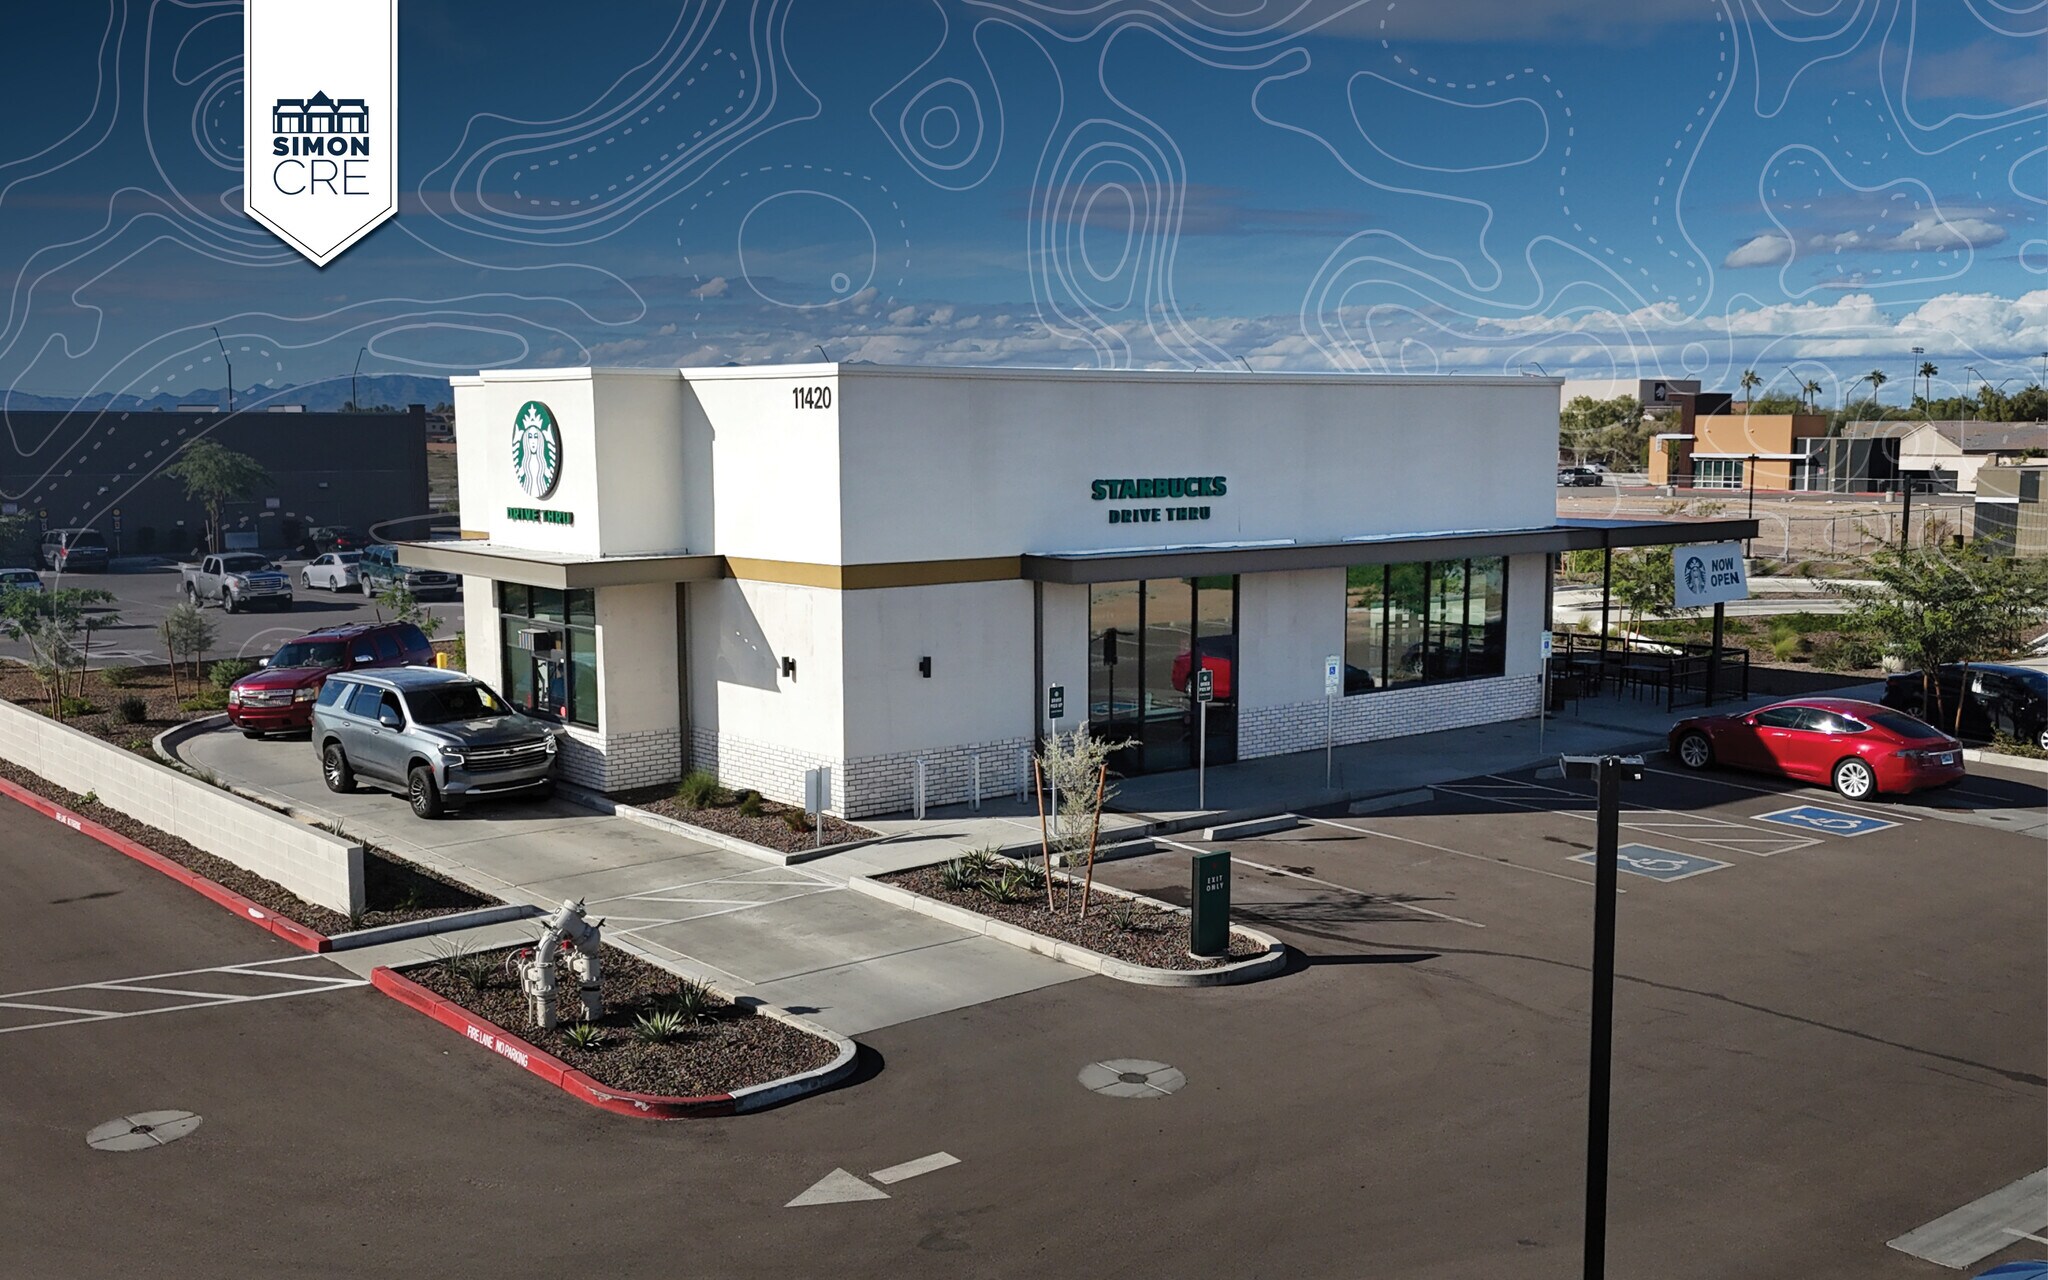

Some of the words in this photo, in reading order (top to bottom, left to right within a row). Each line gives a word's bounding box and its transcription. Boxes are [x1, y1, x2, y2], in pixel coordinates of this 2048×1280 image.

[792, 386, 832, 409] 11420
[1091, 476, 1227, 500] STARBUCKS
[507, 507, 541, 522] DRIVE
[540, 510, 574, 526] THRU
[1109, 508, 1161, 524] DRIVE
[1166, 506, 1211, 521] THRU
[1711, 557, 1734, 572] NOW
[1710, 571, 1740, 587] OPEN
[1206, 882, 1223, 892] ONLY
[1207, 875, 1223, 884] EXIT
[467, 1024, 480, 1042] FIRE
[480, 1031, 494, 1050] LANE
[496, 1039, 505, 1055] NO
[504, 1044, 529, 1068] PARKING
